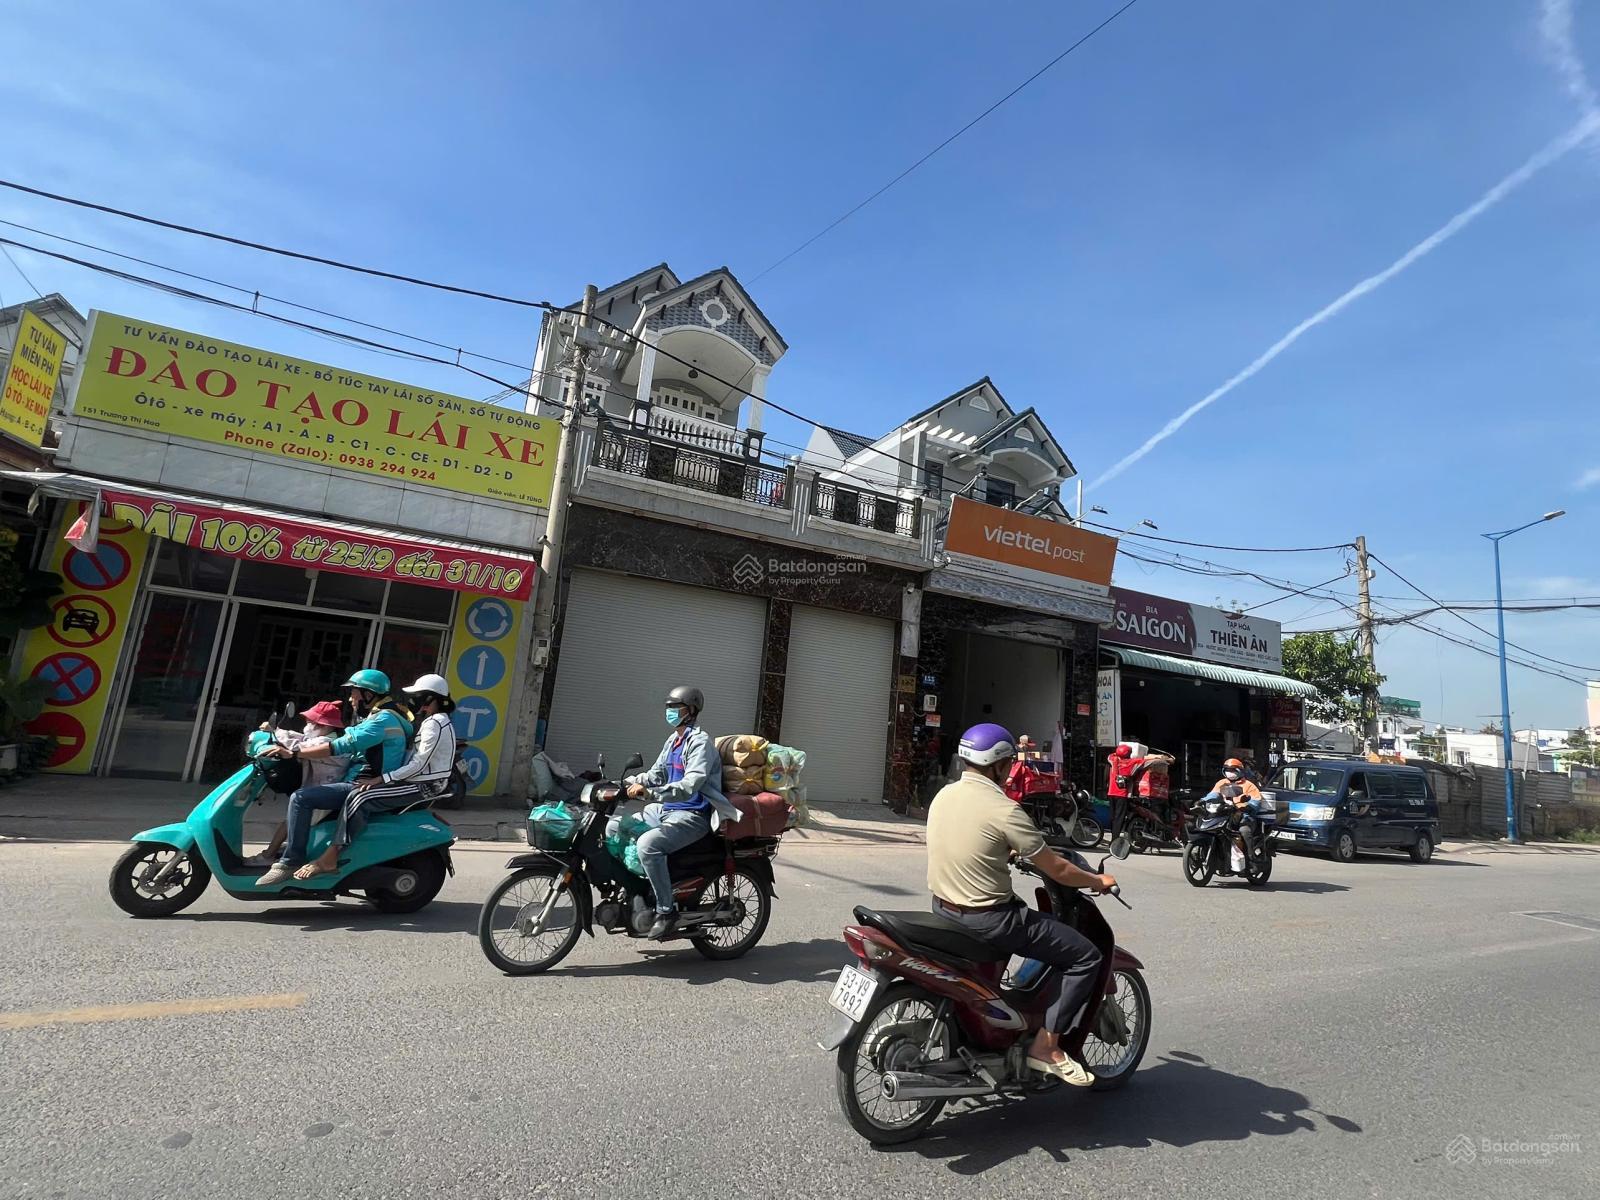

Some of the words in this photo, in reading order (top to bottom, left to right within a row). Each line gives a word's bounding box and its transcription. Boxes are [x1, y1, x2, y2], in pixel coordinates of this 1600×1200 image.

[124, 325, 143, 337] TƯ
[148, 331, 179, 346] VẤN
[185, 340, 218, 354] ĐÀO
[223, 349, 252, 363] TẠO
[257, 357, 278, 369] LÁI
[284, 363, 301, 375] XE
[338, 375, 363, 388] TÚC
[368, 382, 389, 395] TAY
[394, 388, 413, 400] LÁI
[417, 394, 434, 405] SỐ
[469, 406, 487, 417] SỐ
[103, 345, 237, 398] ĐÀO
[257, 380, 369, 426] TẠO
[384, 408, 472, 450] LÁI
[481, 431, 545, 467] XE
[134, 391, 166, 409] Ôtô
[184, 406, 204, 417] xe
[211, 411, 246, 427] máy
[263, 421, 282, 432] A1
[299, 429, 310, 439] A
[326, 434, 335, 443] B
[351, 439, 368, 450] C1
[386, 446, 396, 456] C
[411, 452, 429, 463] CE
[443, 458, 458, 469] D1
[474, 464, 491, 476] D2
[504, 471, 513, 480] D
[224, 430, 274, 449] Phone
[339, 453, 374, 469] 0938
[380, 462, 406, 475] 294
[411, 468, 436, 481] 924
[201, 518, 283, 559] 10%
[291, 535, 329, 561] từ
[323, 540, 394, 571] 25/9
[395, 550, 443, 580] đến
[445, 559, 522, 592] 31/10
[1052, 545, 1087, 564] post
[1116, 610, 1186, 644] SAIGON
[1145, 605, 1158, 615] BIA
[1210, 629, 1247, 650] THIÊN
[1251, 634, 1268, 653] ÂN
